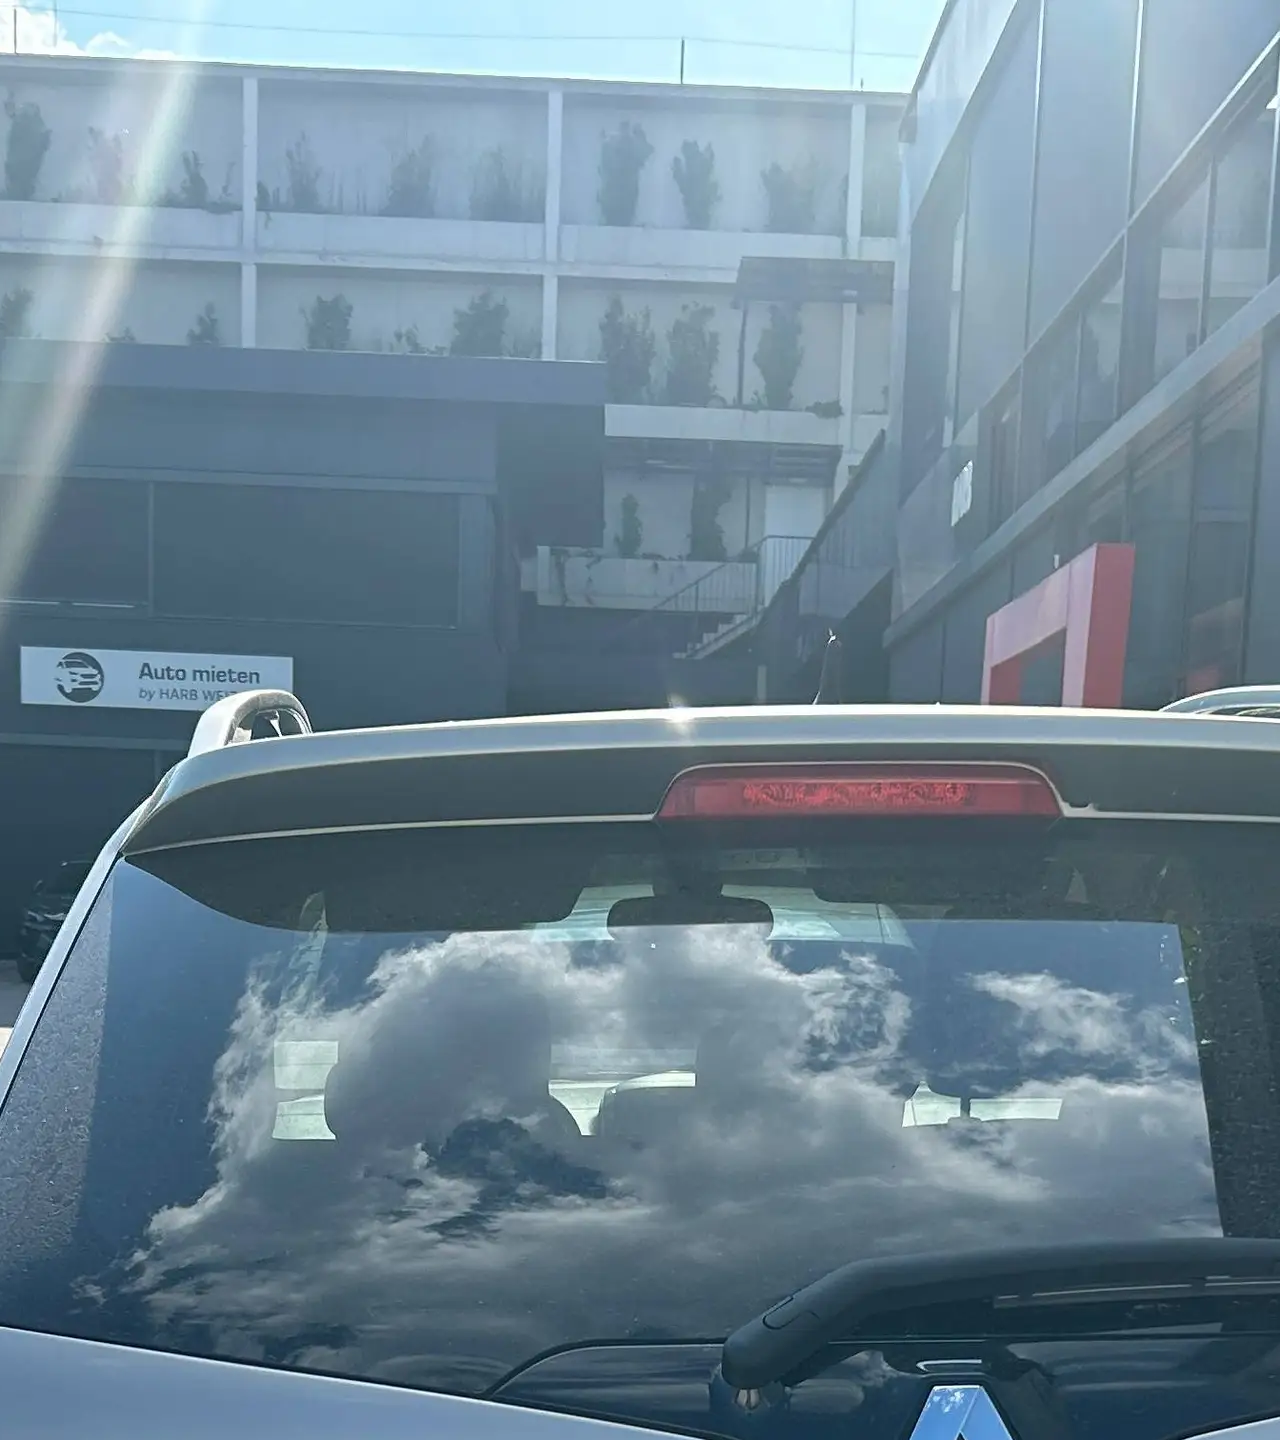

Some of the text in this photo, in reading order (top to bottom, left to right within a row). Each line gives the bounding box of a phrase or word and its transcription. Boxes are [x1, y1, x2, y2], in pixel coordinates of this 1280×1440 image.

[139, 663, 261, 684] Auto mieten
[140, 688, 155, 701] by
[159, 689, 198, 700] HARB
